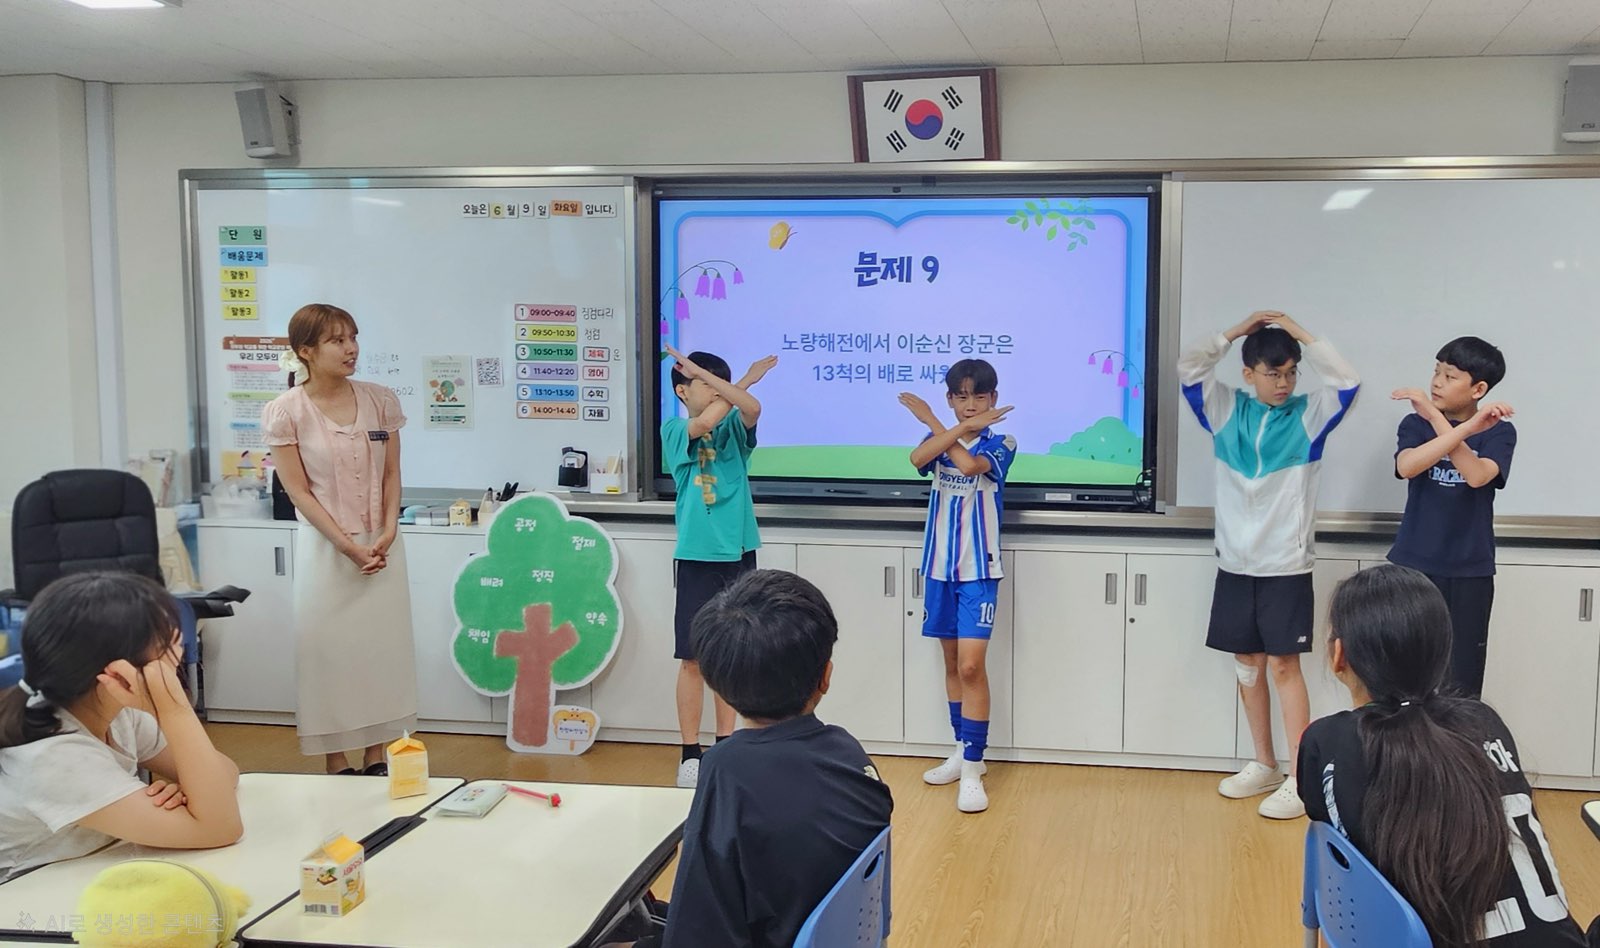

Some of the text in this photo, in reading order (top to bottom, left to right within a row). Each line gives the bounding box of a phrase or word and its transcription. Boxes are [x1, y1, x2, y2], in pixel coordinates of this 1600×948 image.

[463, 202, 615, 216] 오늘은 6 월 9 일 화요일 입니다.
[229, 229, 263, 240] 단 원
[227, 250, 264, 262] 배움문제
[854, 251, 940, 287] 문제 9
[230, 270, 249, 280] 활동1
[229, 288, 250, 299] 활동2
[231, 306, 252, 317] 활동3
[529, 308, 576, 317] 09:00-09:40
[520, 327, 576, 337] 2 09:50-10:30
[781, 332, 1014, 355] 노량해전에서 이순신 장군은
[239, 352, 279, 361] 우리 모두의
[520, 347, 574, 357] 3 10:50-11:30
[520, 366, 575, 376] 4 11:40-12:20
[587, 368, 605, 378] 영어
[812, 363, 872, 384] 13척의
[877, 364, 915, 384] 배로
[521, 387, 529, 397] 5
[587, 389, 605, 399] 수학
[521, 405, 529, 415] 6
[514, 517, 537, 532] 공정
[572, 535, 596, 551] 절제
[531, 569, 555, 584] 정직
[480, 577, 504, 588] 배려
[980, 602, 995, 624] 10
[585, 611, 608, 627] 약속
[468, 628, 491, 644] 책임
